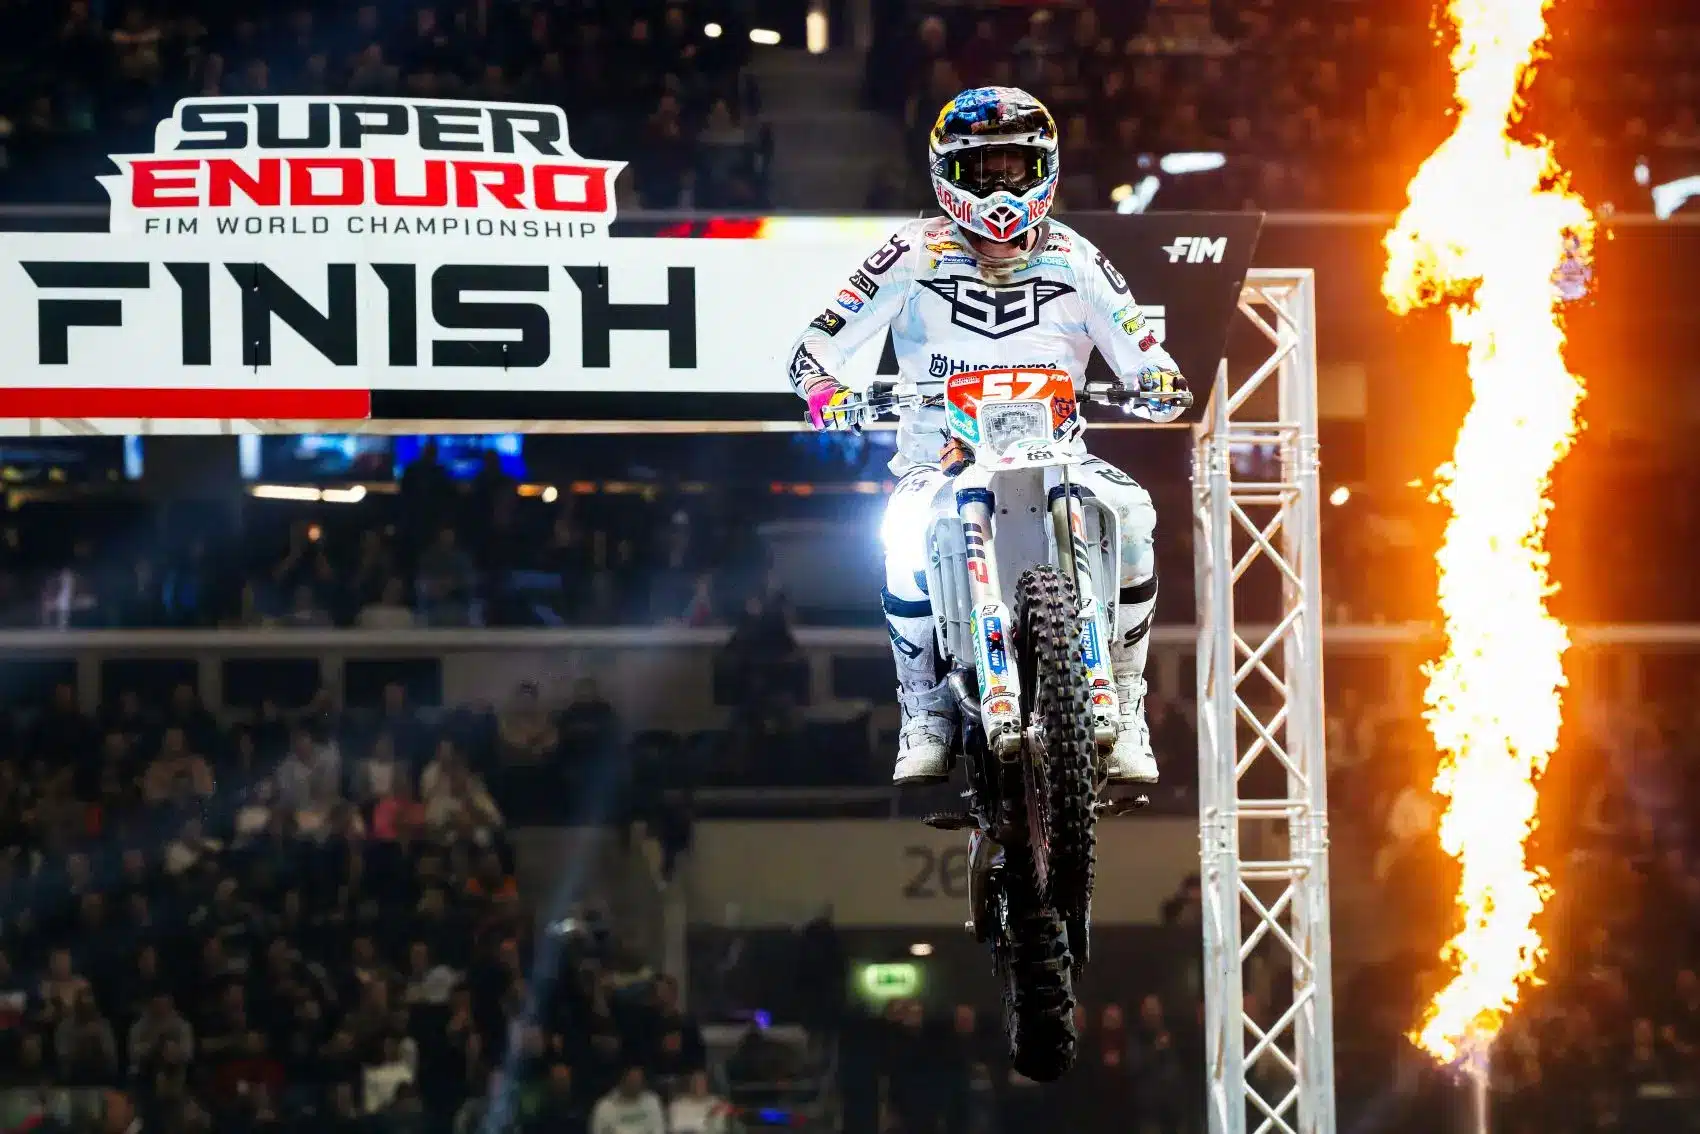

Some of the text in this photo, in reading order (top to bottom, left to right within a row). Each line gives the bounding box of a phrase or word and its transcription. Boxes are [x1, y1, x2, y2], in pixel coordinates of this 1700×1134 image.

[173, 103, 564, 156] SUPER
[129, 158, 609, 213] ENDURO
[144, 216, 597, 238] FIM WORLD CHAMPIONSHIP
[1162, 236, 1228, 264] FIM
[19, 261, 698, 370] FINISH
[981, 372, 1049, 400] 57
[985, 619, 1001, 667] MIIN
